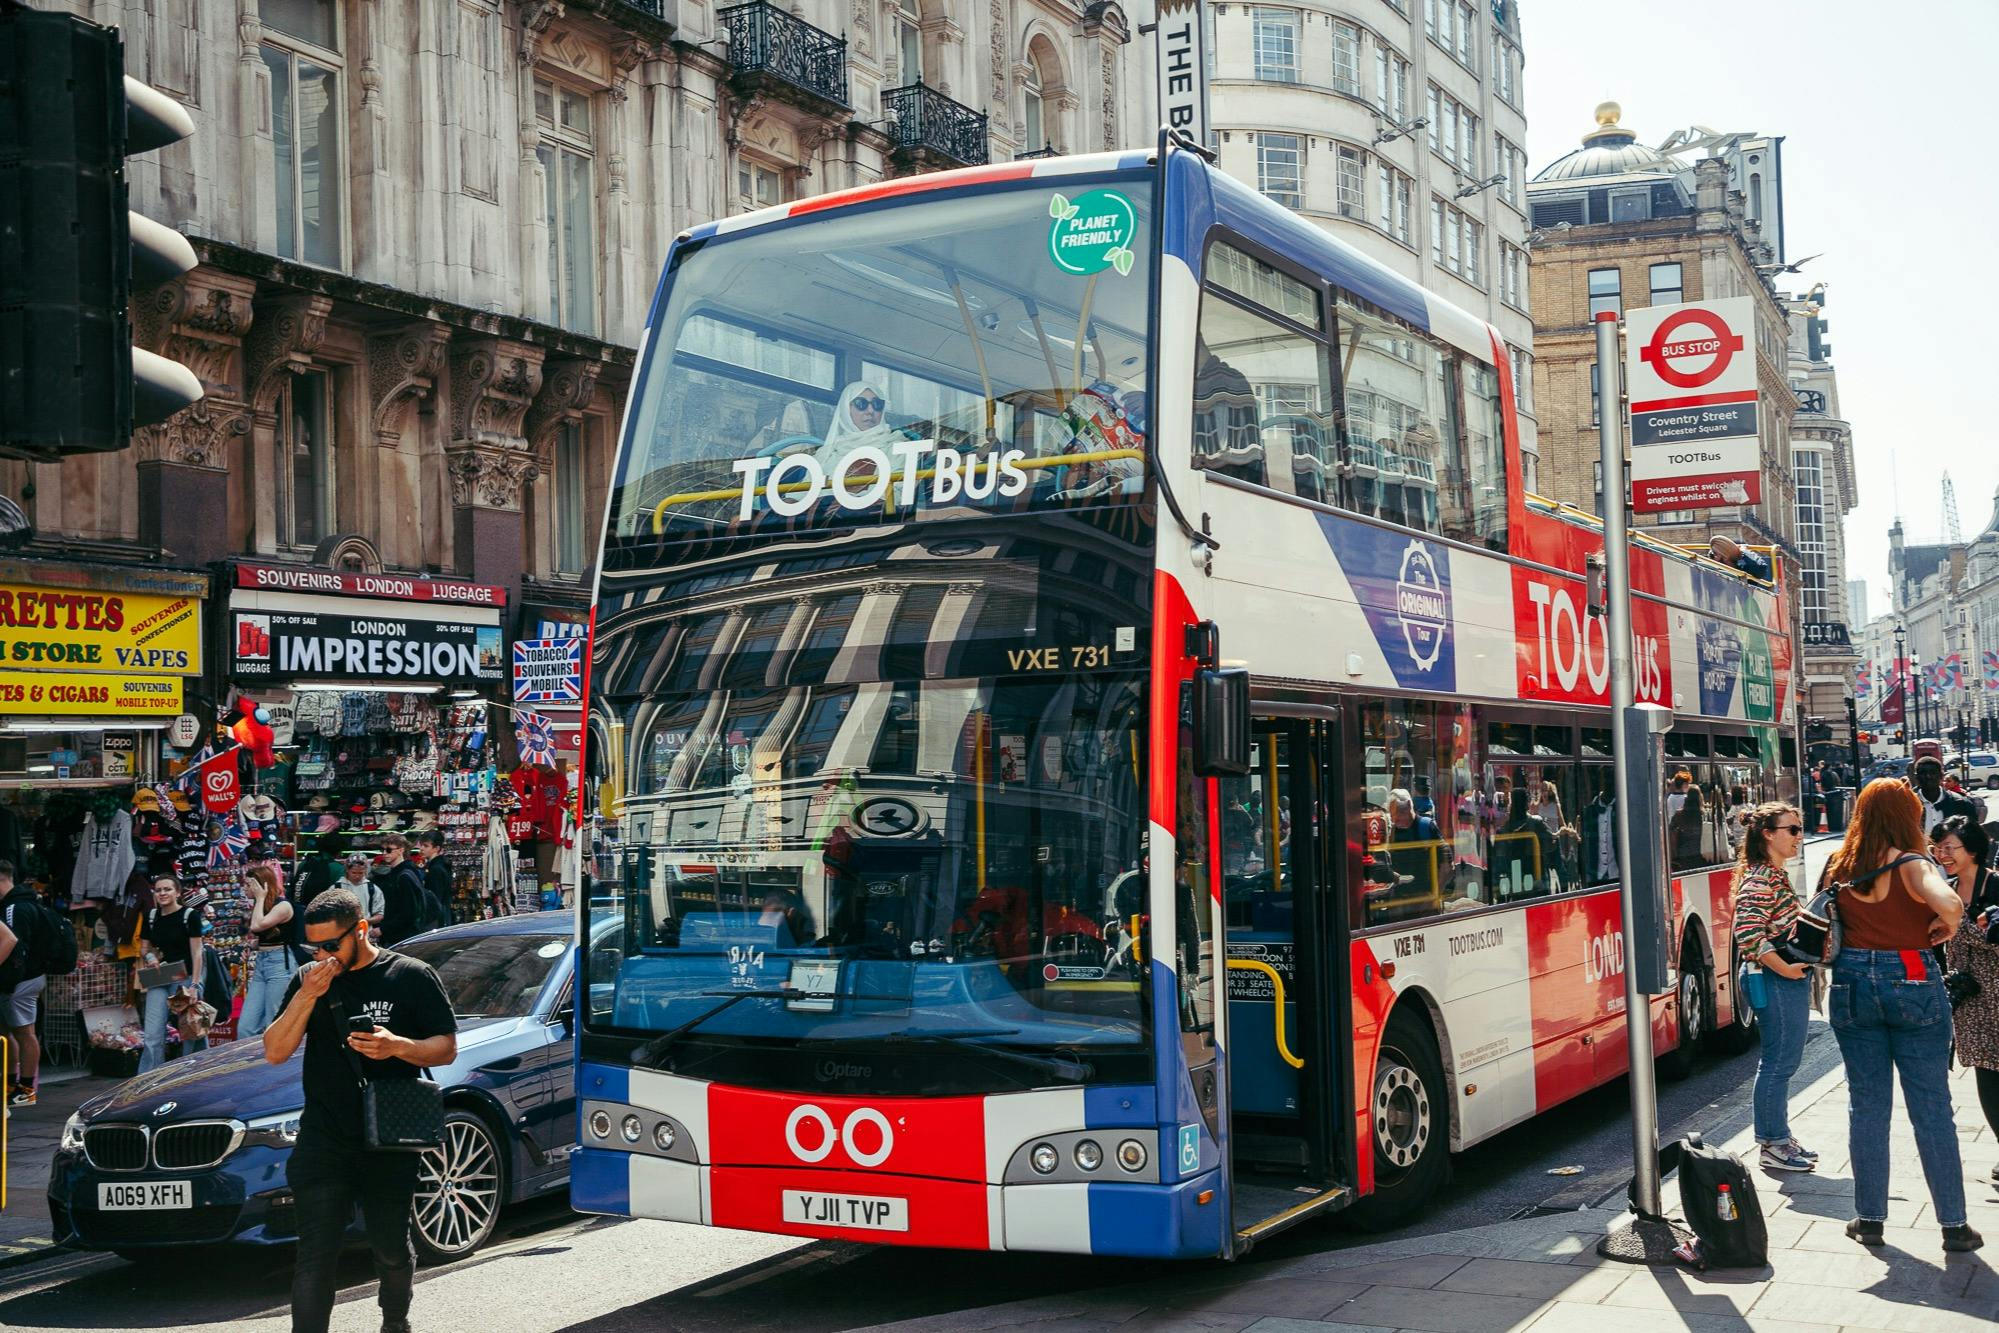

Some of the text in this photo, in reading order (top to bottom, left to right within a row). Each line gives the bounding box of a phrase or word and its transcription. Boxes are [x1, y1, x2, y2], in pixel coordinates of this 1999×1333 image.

[1167, 22, 1192, 95] THE
[1070, 214, 1119, 231] PLANET
[1061, 229, 1122, 248] FRIENDLY
[1661, 340, 1721, 357] BUS STOP
[1648, 410, 1738, 428] Coventry Street
[1658, 423, 1728, 437] Leicester Square
[1646, 487, 1676, 495] Drivers
[1678, 484, 1699, 493] must
[1647, 496, 1679, 505] engines
[1680, 493, 1707, 501] whilst
[257, 569, 492, 602] SOUVENIRS LONDON LUGGAGE
[1414, 570, 1426, 585] The
[1400, 591, 1445, 619] ORIGINAL
[130, 598, 189, 636] SOUVENIRS
[272, 616, 317, 625] 50% OFF SALE
[135, 609, 193, 647] CONFECTIONERY
[351, 620, 406, 637] LONDON
[450, 625, 461, 633] OFF
[462, 626, 474, 634] SALE
[1417, 627, 1430, 641] Tour
[12, 641, 102, 664] STORE
[115, 647, 188, 668] VAPES
[280, 635, 480, 676] IMPRESSION
[525, 648, 568, 663] TOBACCO
[1008, 645, 1110, 671] VXE 731
[236, 663, 270, 673] LUGGAGE
[521, 662, 573, 678] SOUVENIRS
[123, 682, 172, 693] SOUVENIRS
[531, 678, 565, 692] MOBILE
[30, 685, 44, 703] &
[49, 686, 109, 703] CIGARS
[115, 698, 179, 708] MOBILE TOP-UP
[105, 738, 132, 748] zippo
[108, 765, 129, 773] CCTV
[207, 792, 235, 803] WALL'S
[1394, 936, 1411, 958] VXE
[1449, 927, 1504, 957] TOOTBUS.COM
[807, 974, 824, 989] Y7
[1227, 971, 1265, 979] TANDING
[363, 1001, 394, 1012] AMIRI
[824, 1060, 873, 1080] Optare
[150, 1184, 184, 1206] XFH
[800, 1195, 890, 1226] YJ11 TVP
